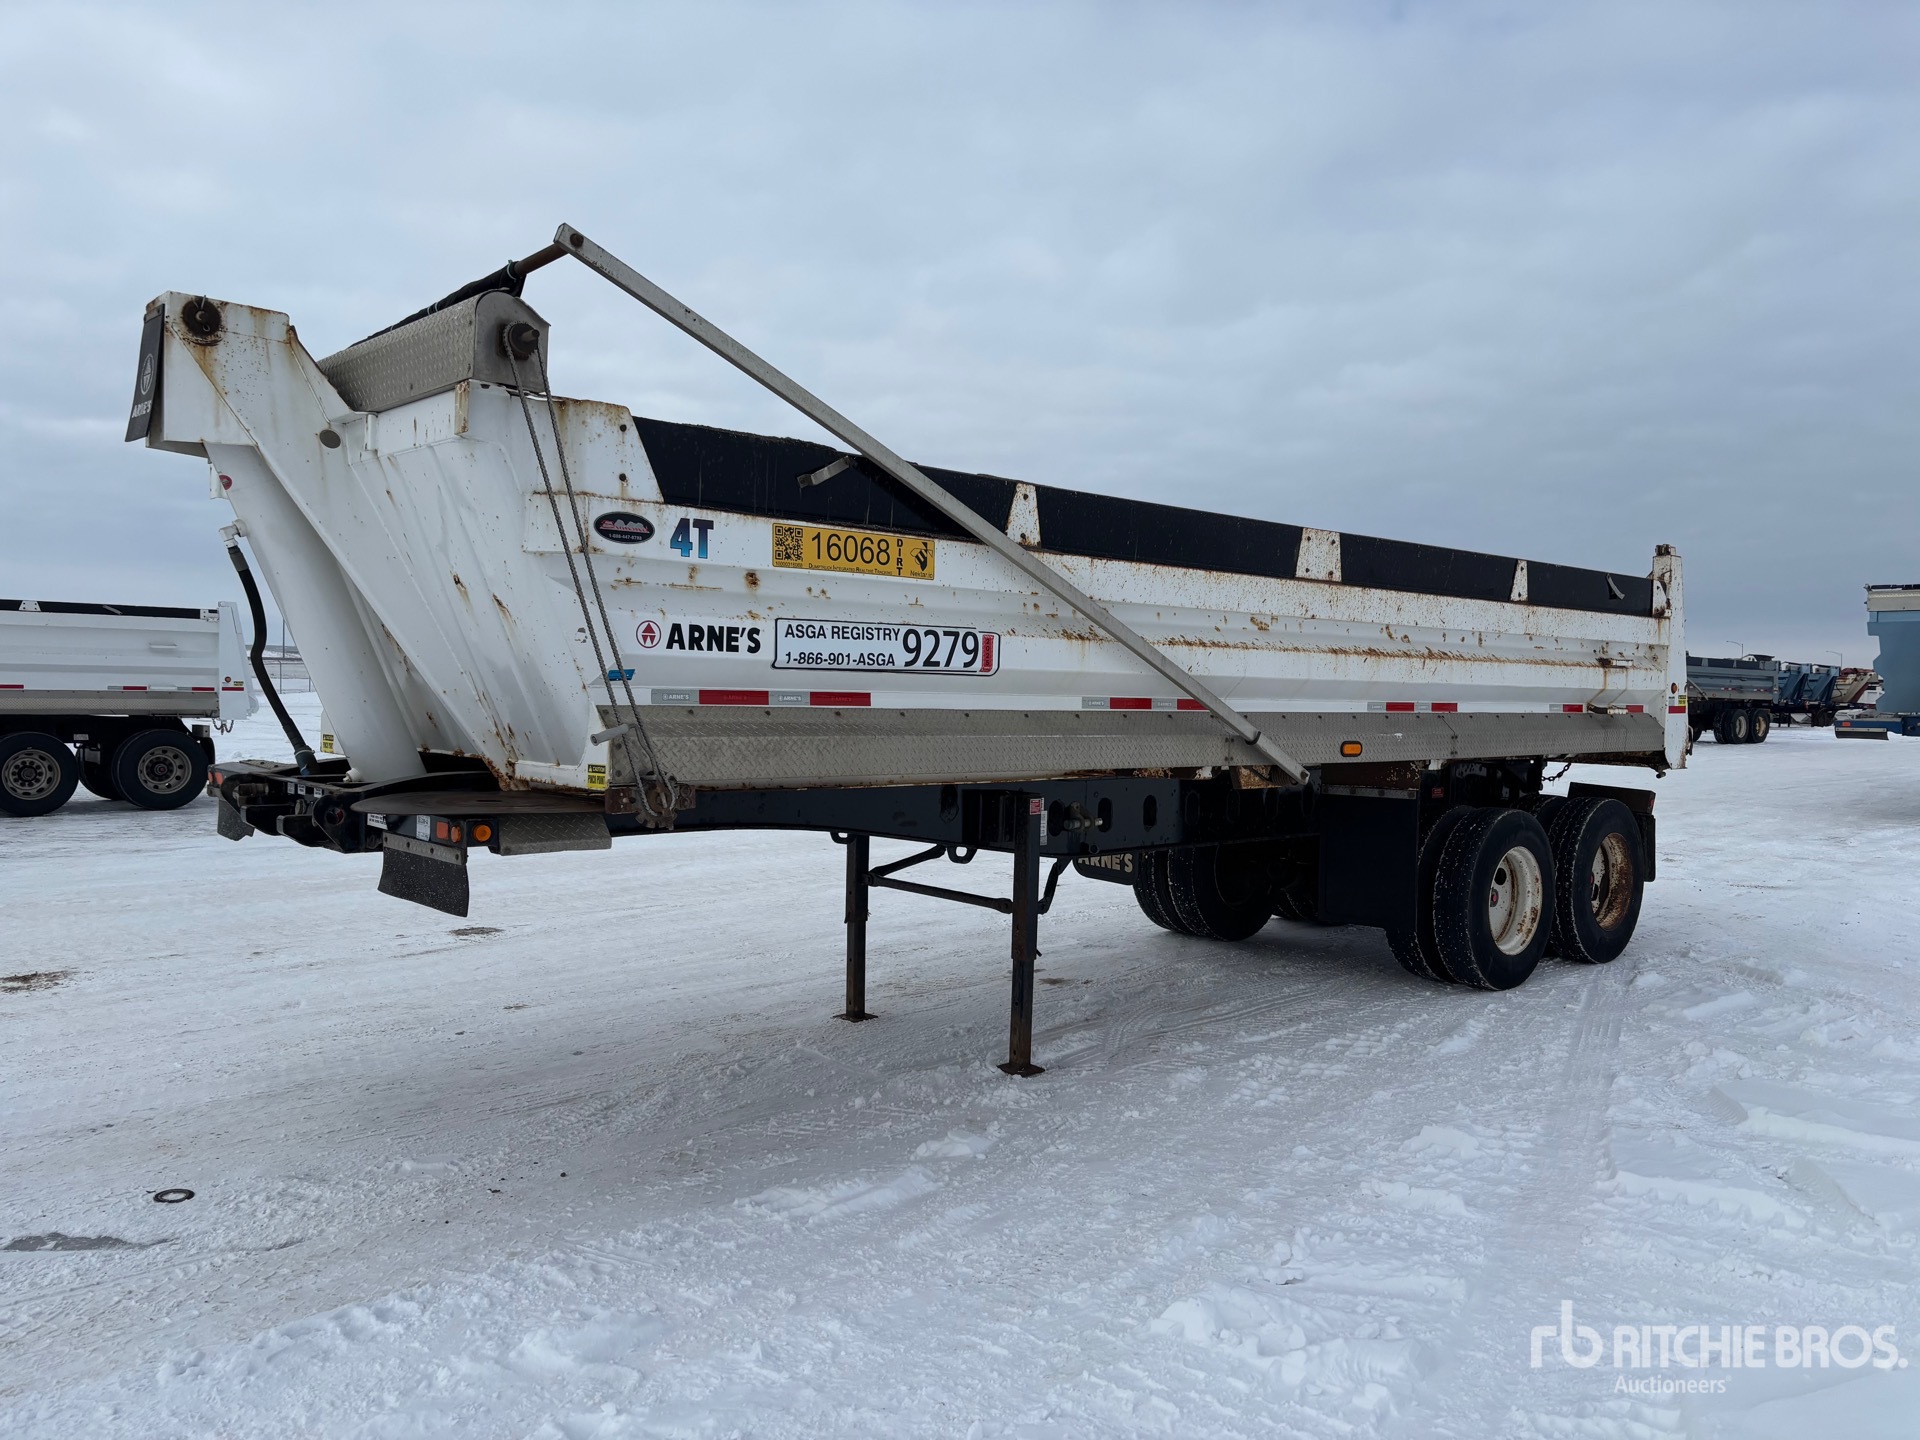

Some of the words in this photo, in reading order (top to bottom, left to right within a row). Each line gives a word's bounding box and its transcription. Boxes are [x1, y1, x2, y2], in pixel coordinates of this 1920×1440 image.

[670, 517, 714, 559] 4T
[811, 531, 891, 566] 16068
[666, 623, 761, 654] ARNE'S
[784, 624, 827, 640] ASGA
[831, 625, 900, 642] REGISTRY
[902, 628, 980, 668] 9279
[785, 651, 895, 667] 1-866-901-ASGA
